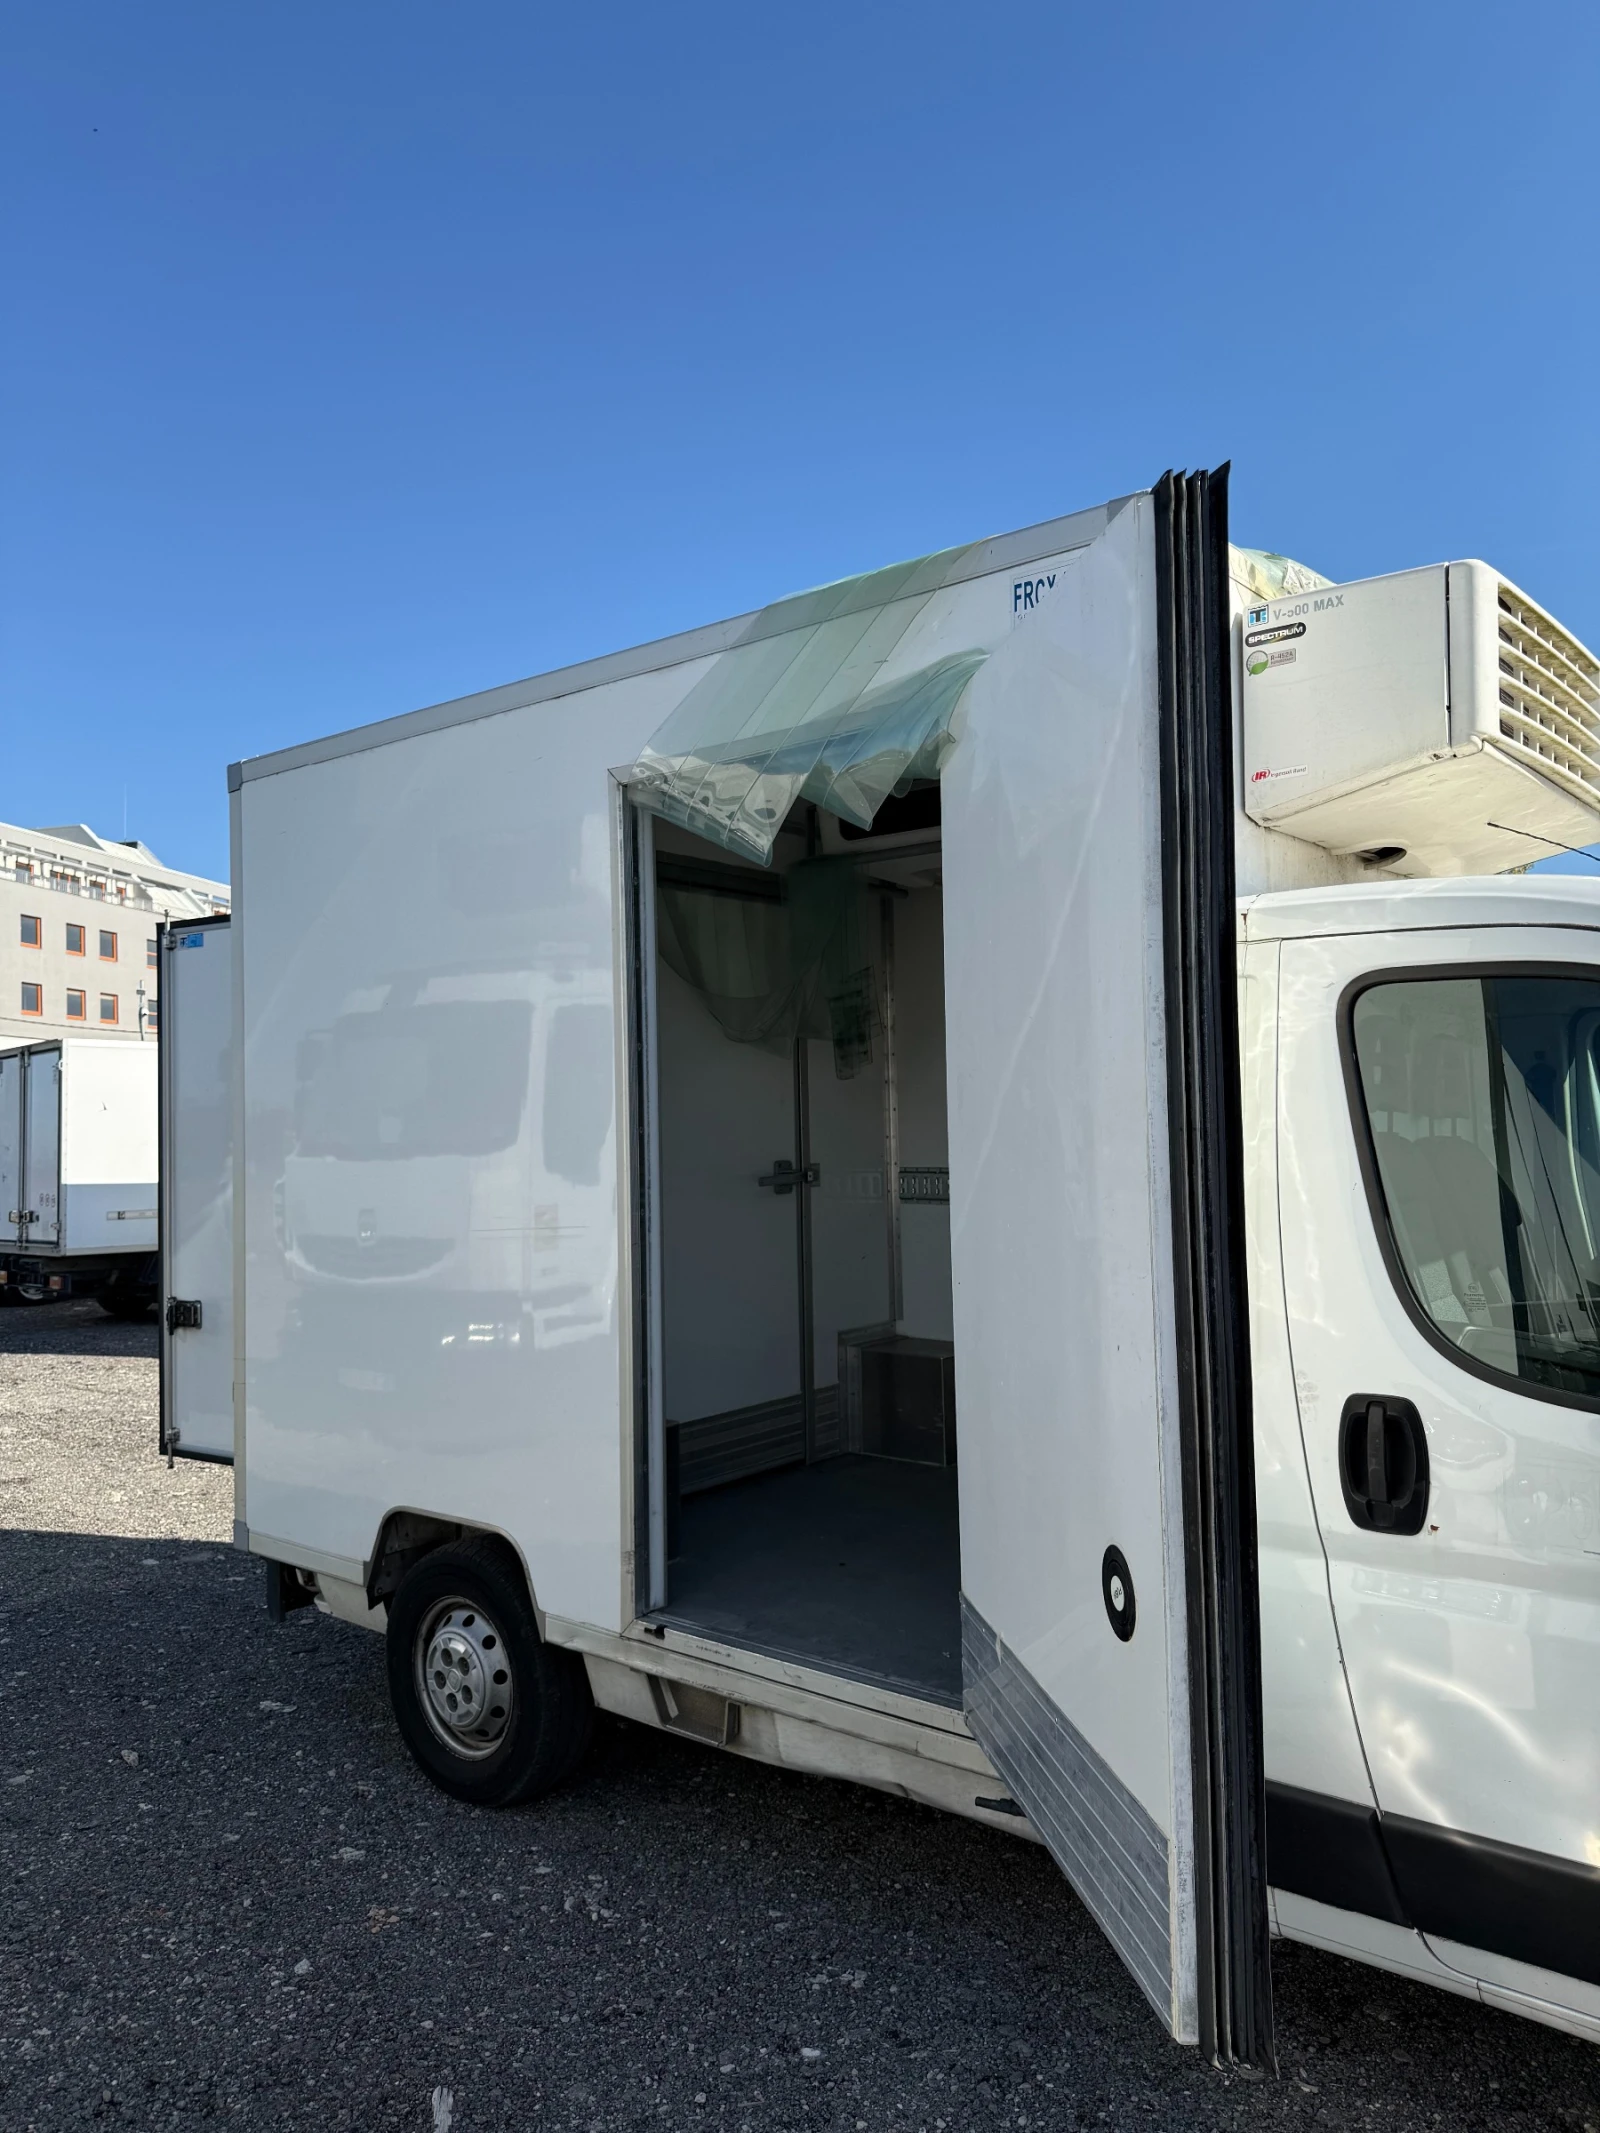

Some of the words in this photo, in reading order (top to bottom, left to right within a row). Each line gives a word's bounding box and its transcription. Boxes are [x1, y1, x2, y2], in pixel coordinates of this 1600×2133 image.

[1313, 594, 1344, 612] MAX
[1248, 626, 1303, 644] SPECTRUM
[1254, 770, 1268, 781] IR
